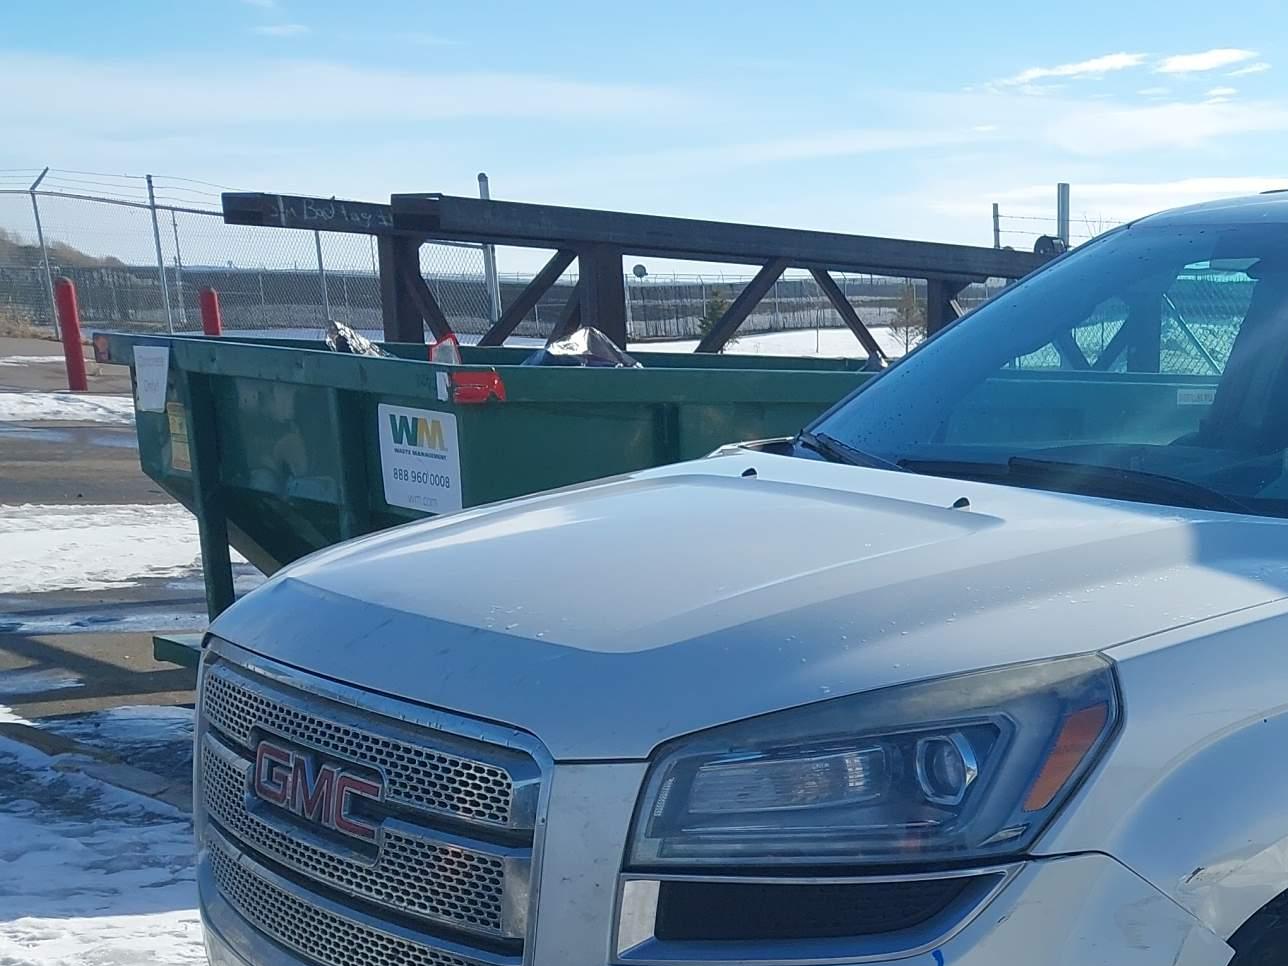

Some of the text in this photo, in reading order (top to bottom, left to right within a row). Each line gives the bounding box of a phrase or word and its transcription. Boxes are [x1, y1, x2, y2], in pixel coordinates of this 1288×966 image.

[389, 414, 448, 451] WM
[393, 467, 450, 489] 888 960 0008
[255, 740, 384, 843] GMC
